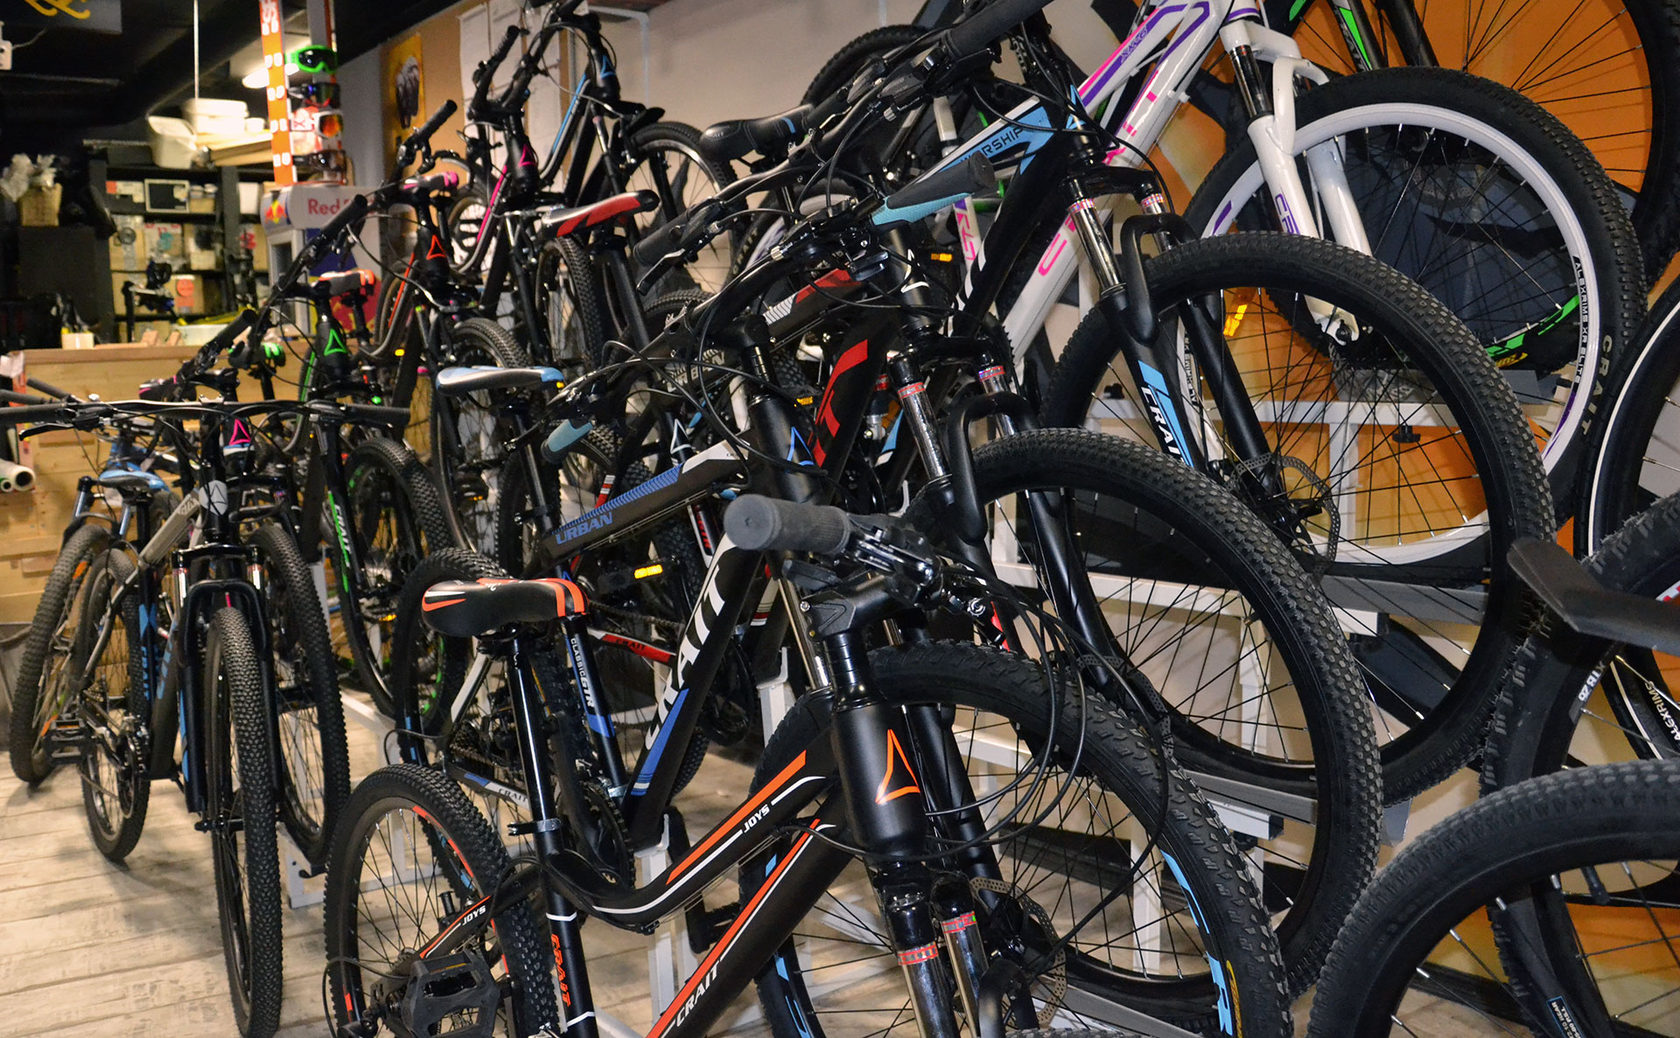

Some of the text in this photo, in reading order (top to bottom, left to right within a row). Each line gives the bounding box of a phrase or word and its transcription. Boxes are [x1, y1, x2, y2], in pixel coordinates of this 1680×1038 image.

[960, 126, 1025, 162] RSHIP
[307, 199, 340, 216] Red
[1574, 260, 1589, 322] ALEXRIMS
[1574, 347, 1587, 384] ELITE
[1582, 334, 1613, 436] CRAIT
[556, 512, 613, 545] URBAN
[570, 638, 586, 677] CLASSIC
[1644, 681, 1680, 740] ALEXRIMS
[498, 787, 528, 803] CRAIT
[743, 803, 770, 834] JOYS
[462, 905, 486, 926] JOYS
[551, 933, 571, 1007] CRAIT
[676, 960, 720, 1028] CRAIT
